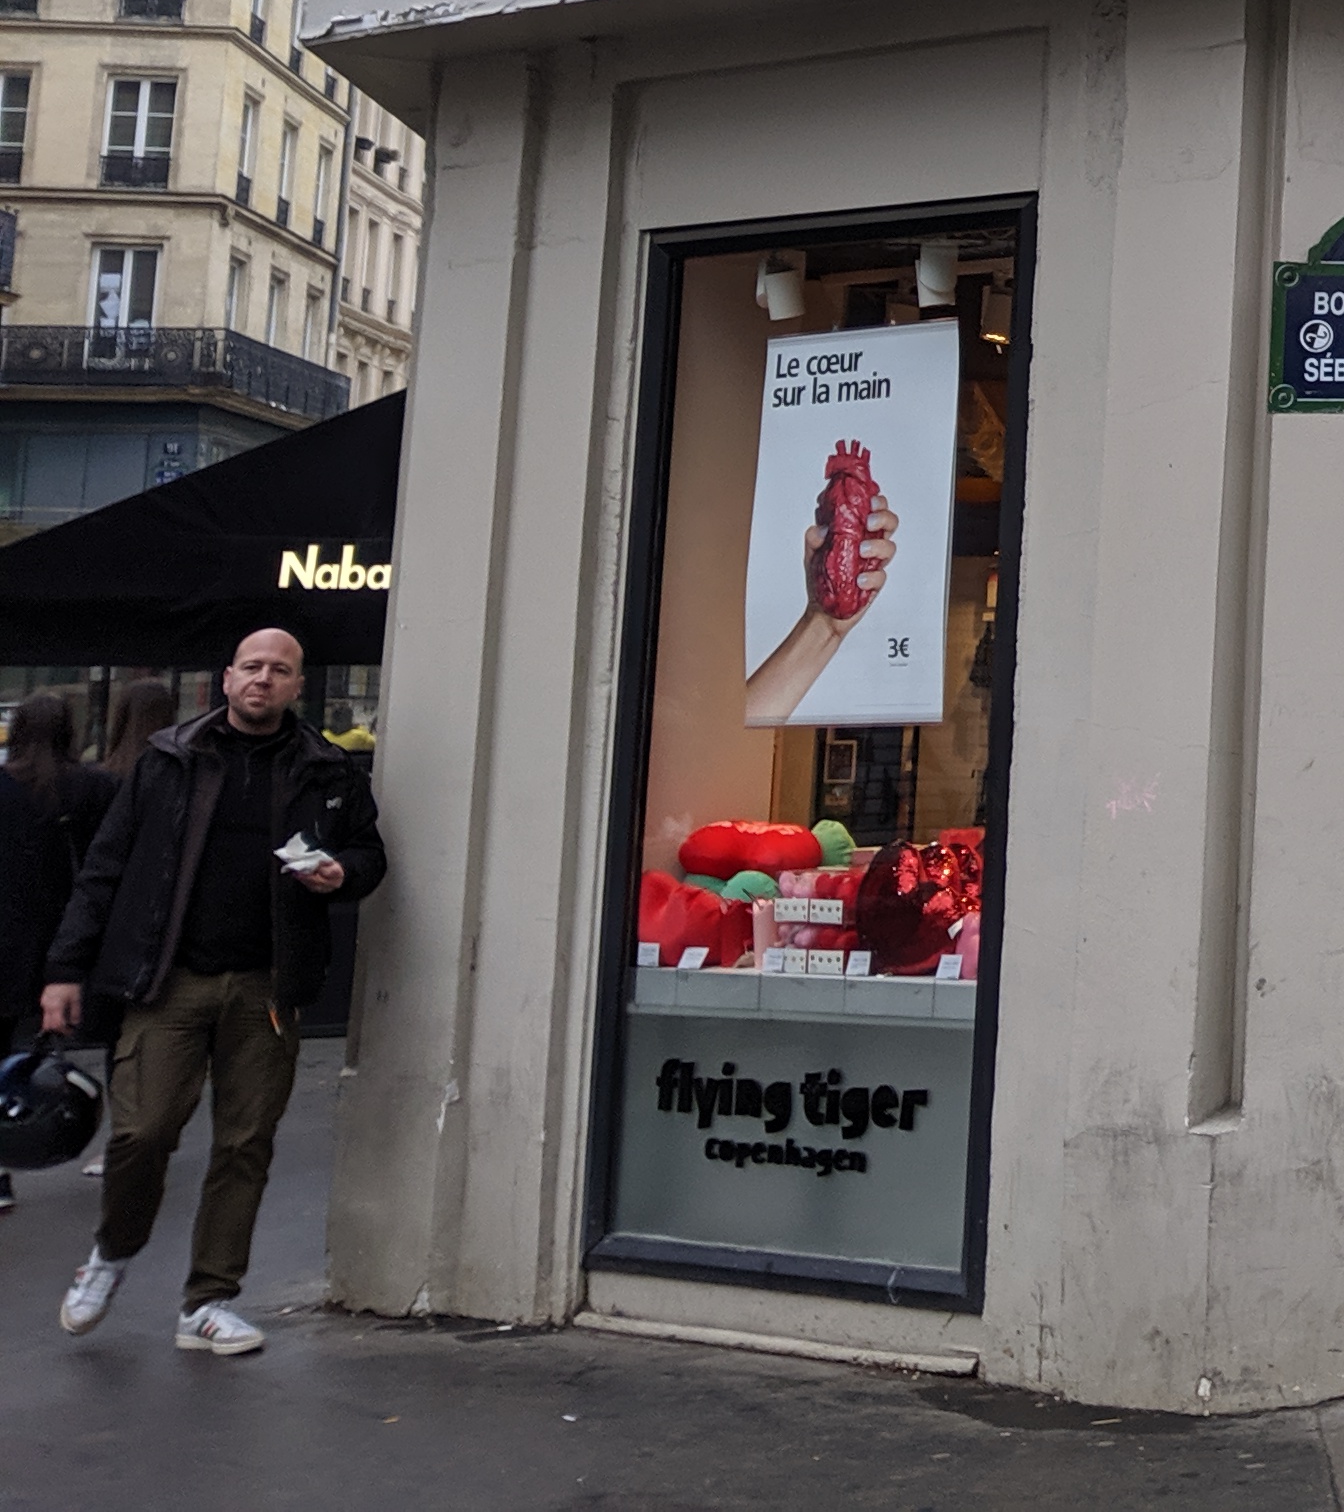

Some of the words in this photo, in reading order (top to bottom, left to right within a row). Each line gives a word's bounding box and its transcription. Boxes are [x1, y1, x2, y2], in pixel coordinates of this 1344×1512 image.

[776, 354, 800, 379] Le
[806, 351, 863, 376] cœur
[772, 385, 806, 408] sur
[812, 377, 830, 404] la
[837, 371, 891, 402] main
[278, 544, 392, 590] Naba
[888, 637, 909, 658] 3€
[656, 1058, 792, 1134] flying
[800, 1068, 929, 1140] tiger
[705, 1136, 868, 1178] copenhagen
